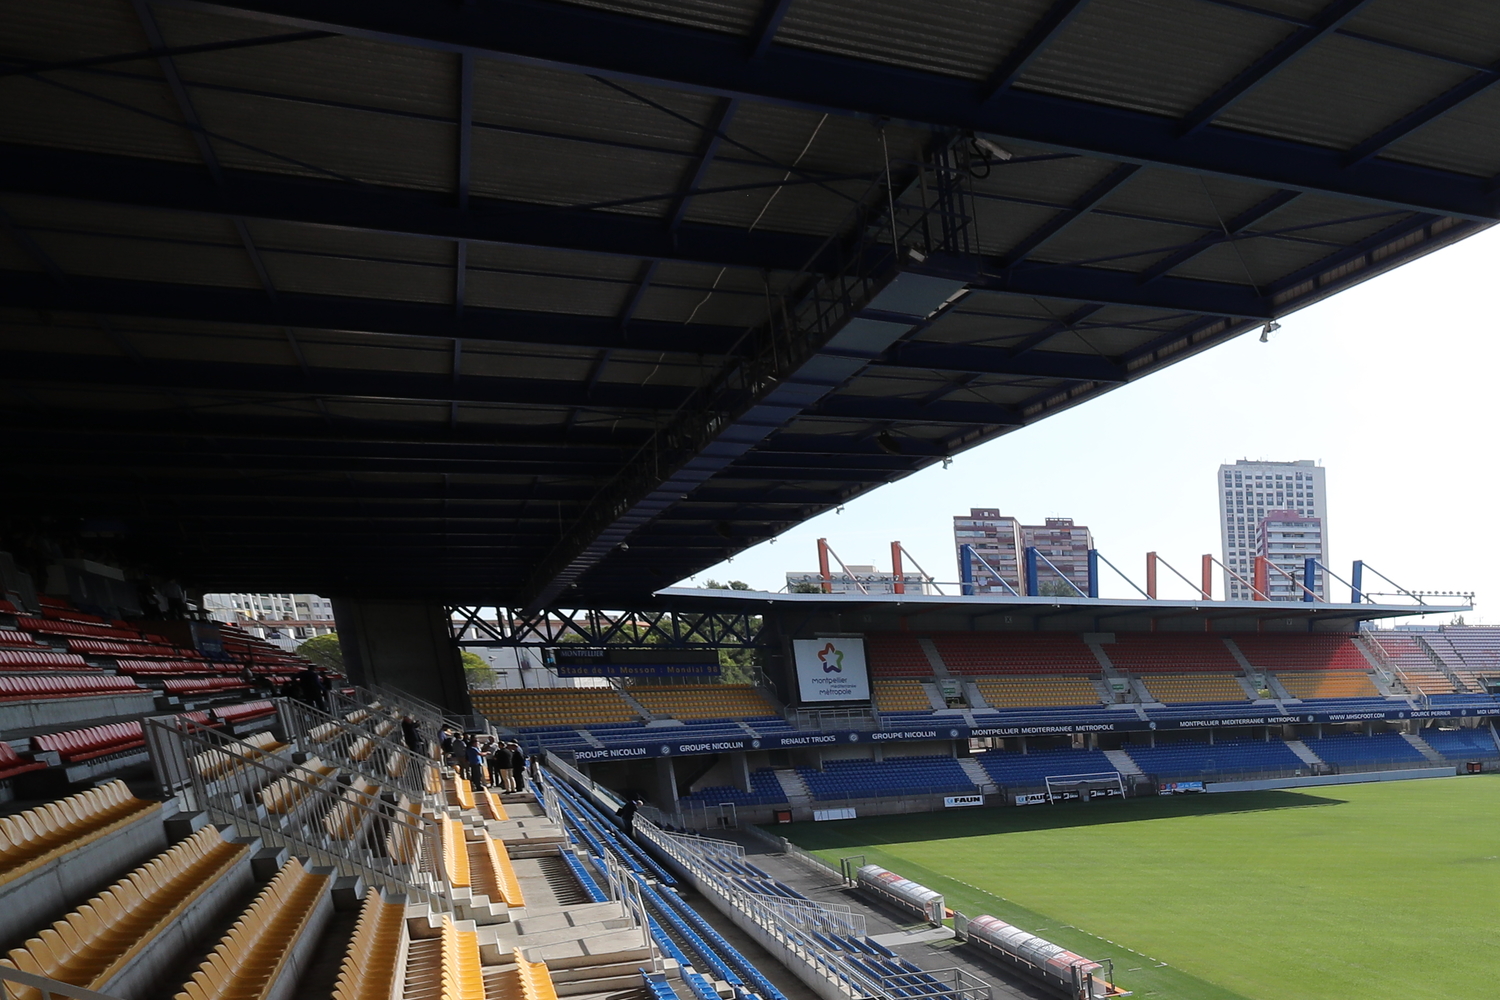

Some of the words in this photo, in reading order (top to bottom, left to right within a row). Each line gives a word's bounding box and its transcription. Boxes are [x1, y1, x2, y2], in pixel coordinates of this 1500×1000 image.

[560, 666, 588, 674] Stade
[592, 666, 602, 674] de
[620, 666, 656, 674] Mosson
[667, 666, 703, 674] Mondial
[904, 730, 936, 738] NICOLLIN
[972, 728, 1018, 736] MONTPELLIER
[1022, 726, 1072, 734] MEDITERRANEE
[1076, 724, 1114, 732] METROPOLE
[780, 738, 810, 746] RENAULT
[812, 735, 836, 743] TRUCKS
[680, 743, 711, 752] GROUPE
[712, 741, 744, 750] NICOLLIN
[575, 750, 608, 760] GROUPE
[610, 748, 646, 758] NICOLLIN
